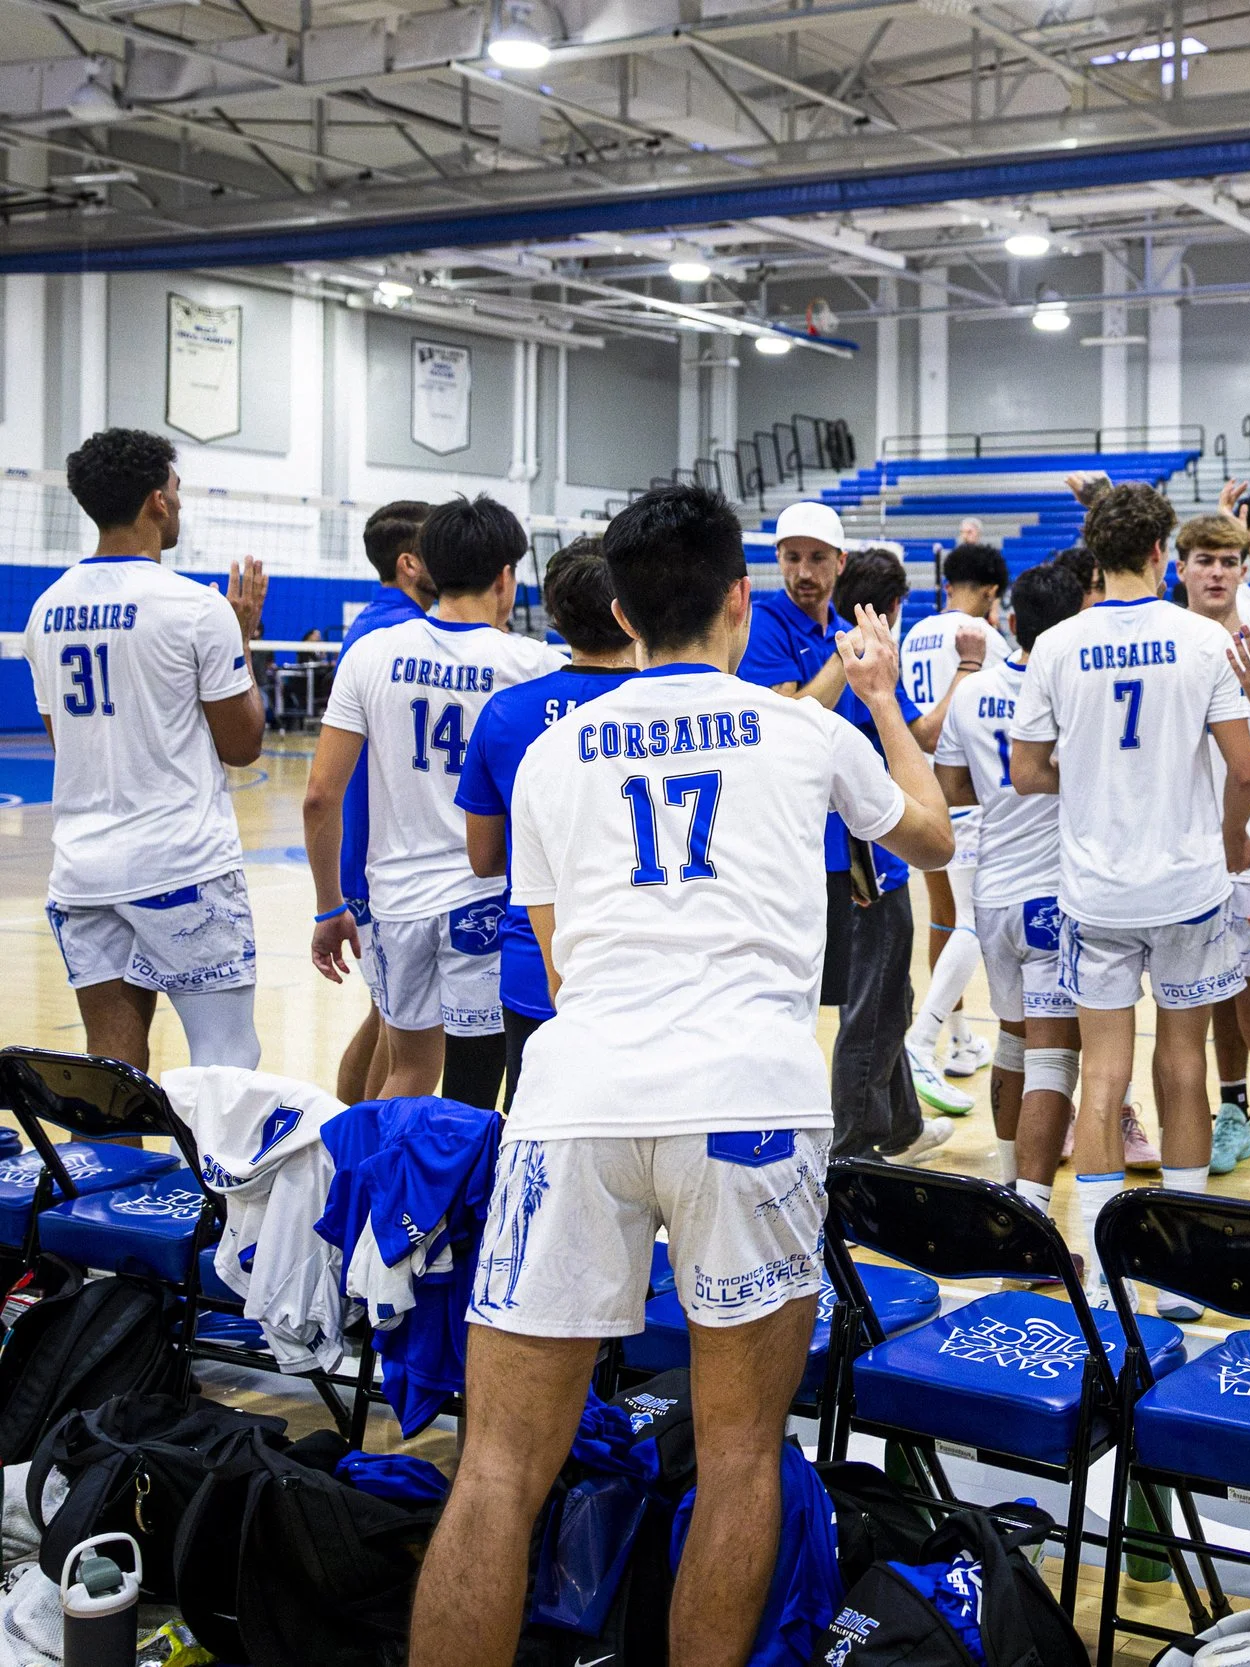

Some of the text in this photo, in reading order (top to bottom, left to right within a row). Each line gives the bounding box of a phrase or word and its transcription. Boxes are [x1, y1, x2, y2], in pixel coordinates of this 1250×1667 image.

[44, 603, 138, 633] CORSAIRS
[391, 656, 495, 693] CORSAIRS
[1080, 640, 1177, 672] CORSAIRS
[60, 643, 116, 717] 31
[912, 659, 935, 703] 21
[1113, 678, 1144, 750] 7
[410, 697, 469, 776] 14
[578, 709, 762, 763] CORSAIRS
[621, 770, 722, 886] 17
[132, 959, 240, 990] VOLLEYBALL
[192, 959, 235, 975] COLLEGE
[718, 1265, 765, 1287] MONICA
[938, 1339, 1075, 1379] SANTA
[828, 1623, 867, 1646] VOLLEYBALL
[834, 1607, 880, 1638] SMC
